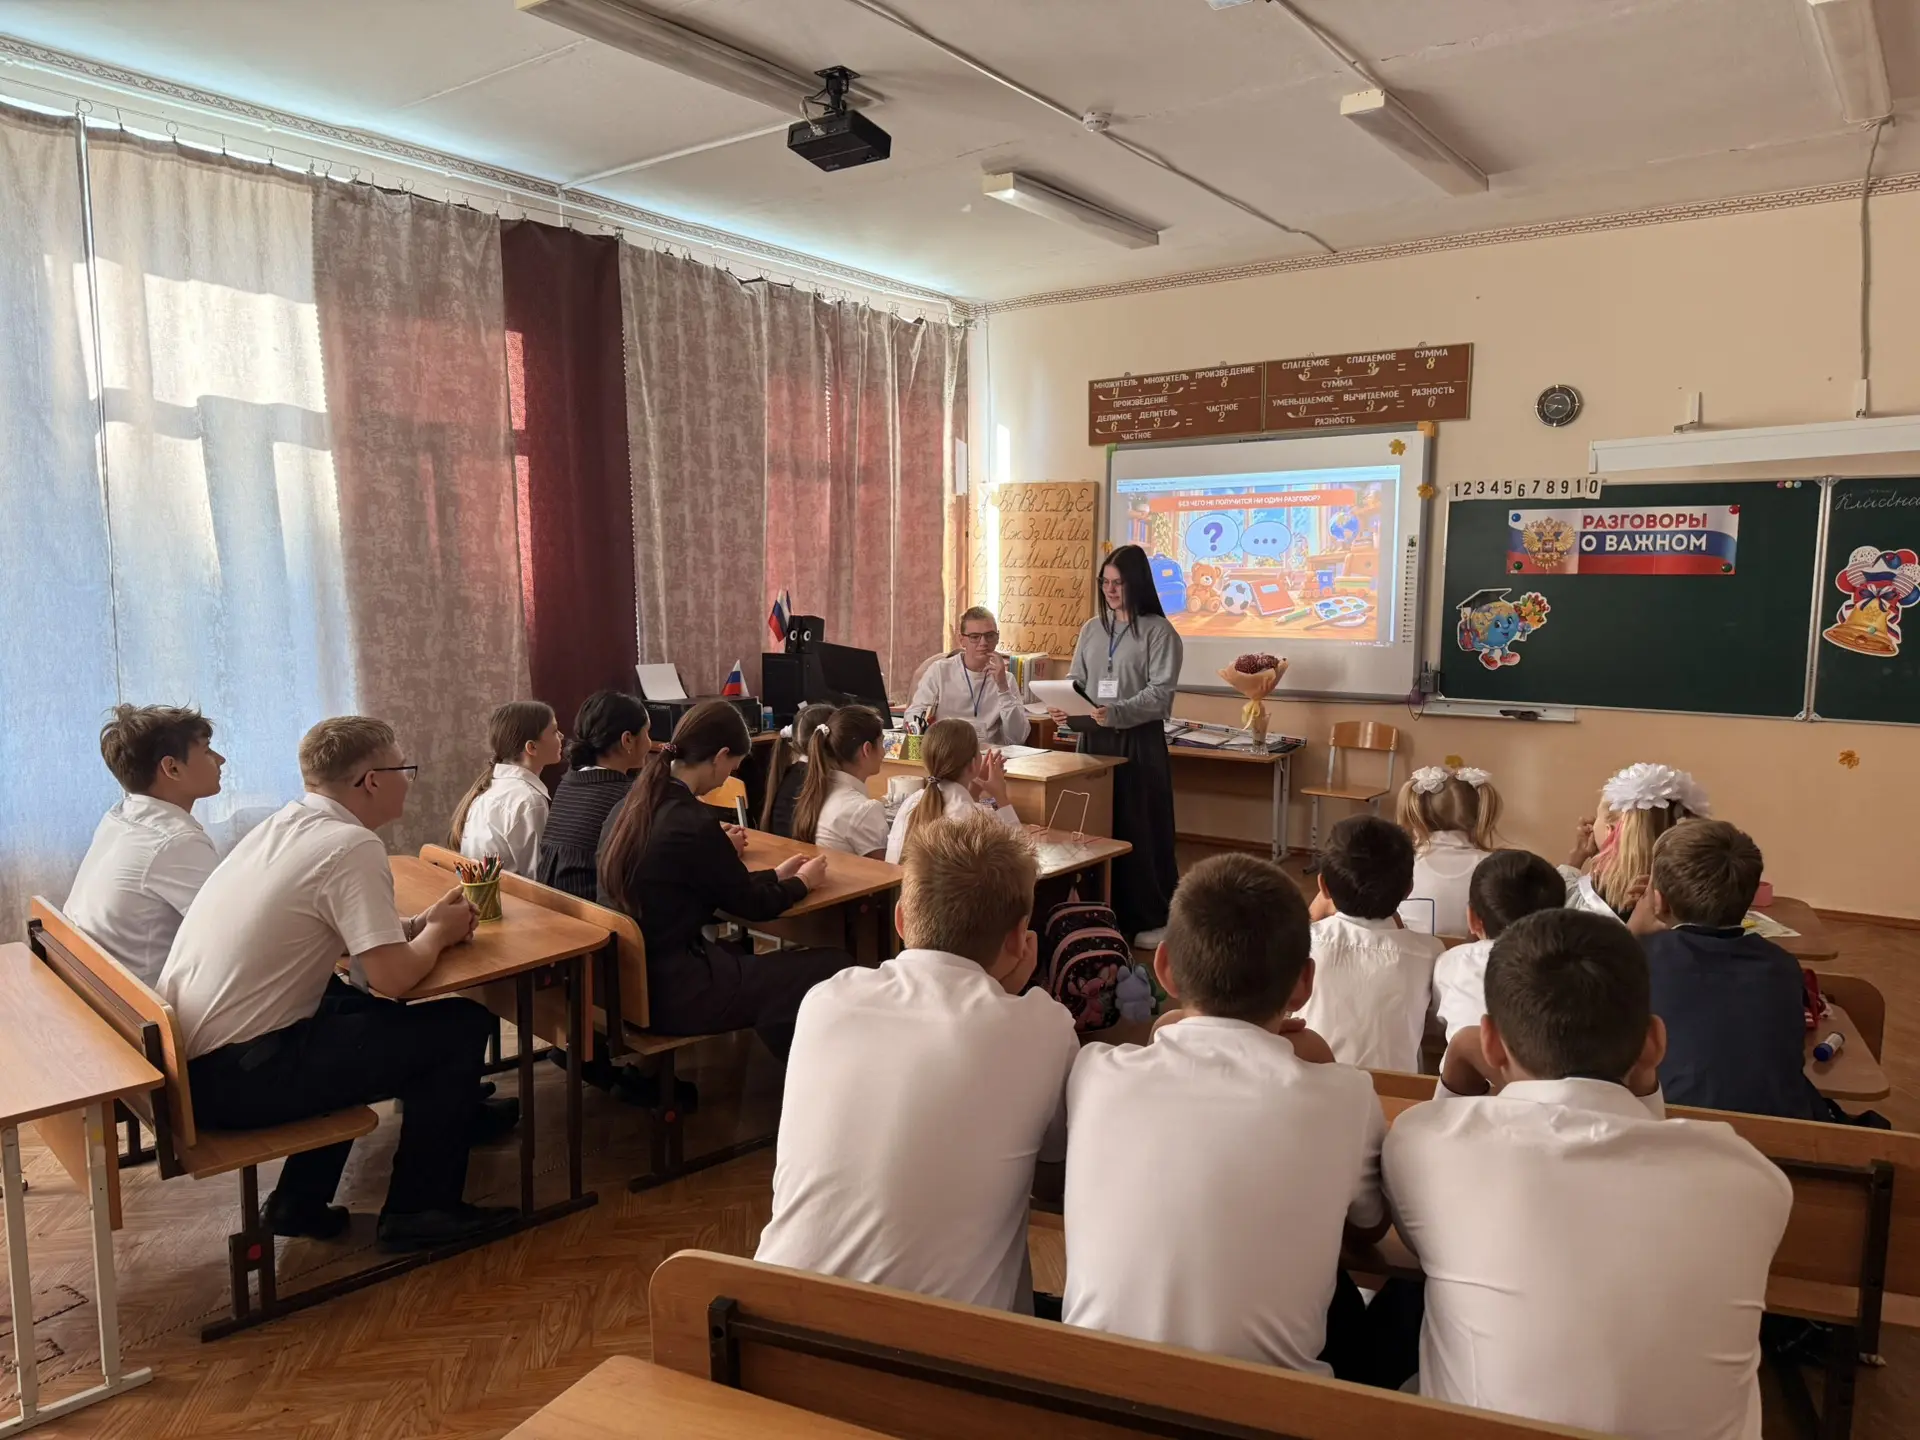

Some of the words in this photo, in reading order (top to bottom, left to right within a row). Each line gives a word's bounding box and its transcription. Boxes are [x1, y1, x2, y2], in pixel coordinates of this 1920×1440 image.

[1282, 358, 1330, 370] СЛАГАЕМОЕ
[1346, 352, 1396, 364] СЛАГАЕМОЕ
[1414, 348, 1448, 359] СУММА
[1303, 368, 1311, 379] 5
[1334, 366, 1343, 376] +
[1367, 362, 1376, 374] 3
[1397, 363, 1406, 372] =
[1426, 357, 1436, 370] 8
[1093, 379, 1138, 390] МНОЖИТЕЛЬ
[1143, 373, 1190, 385] МНОЖИТЕЛЬ
[1195, 366, 1256, 380] ПРОИЗВЕДЕНИЕ
[1112, 387, 1120, 398] 4
[1162, 383, 1169, 394] 2
[1190, 382, 1197, 390] =
[1221, 376, 1228, 388] 8
[1321, 378, 1353, 389] СУММА
[1113, 396, 1168, 408] ПРОИЗВЕДЕНИЕ
[1272, 394, 1334, 407] УМЕНЬШАЕМОЕ
[1343, 390, 1400, 402] ВЫЧИТАЕМОЕ
[1411, 386, 1455, 397] РАЗНОСТЬ
[1096, 412, 1132, 422] ДЕЛИМОЕ
[1138, 409, 1178, 419] ДЕЛИТЕЛЬ
[1206, 403, 1239, 413] ЧАСТНОЕ
[1298, 405, 1307, 416] 9
[1366, 400, 1375, 412] 3
[1396, 400, 1405, 408] =
[1427, 396, 1436, 408] 6
[1110, 421, 1118, 432] 6
[1153, 417, 1161, 428] 3
[1186, 418, 1193, 426] =
[1218, 412, 1226, 423] 2
[1314, 416, 1356, 426] РАЗНОСТЬ
[1121, 432, 1152, 441] ЧАСТНОЕ
[1454, 483, 1460, 496] 1
[1463, 482, 1472, 496] 2
[1476, 481, 1485, 494] 3
[1490, 481, 1499, 494] 4
[1503, 480, 1512, 494] 5
[1517, 484, 1526, 497] 6
[1532, 480, 1541, 494] 7
[1546, 480, 1555, 494] 8
[1560, 480, 1569, 494] 9
[1284, 495, 1320, 503] РАЗГОВОР?
[1582, 513, 1708, 530] РАЗГОВОРЫ
[1581, 535, 1597, 552] О
[1605, 534, 1707, 552] ВАЖНОМ
